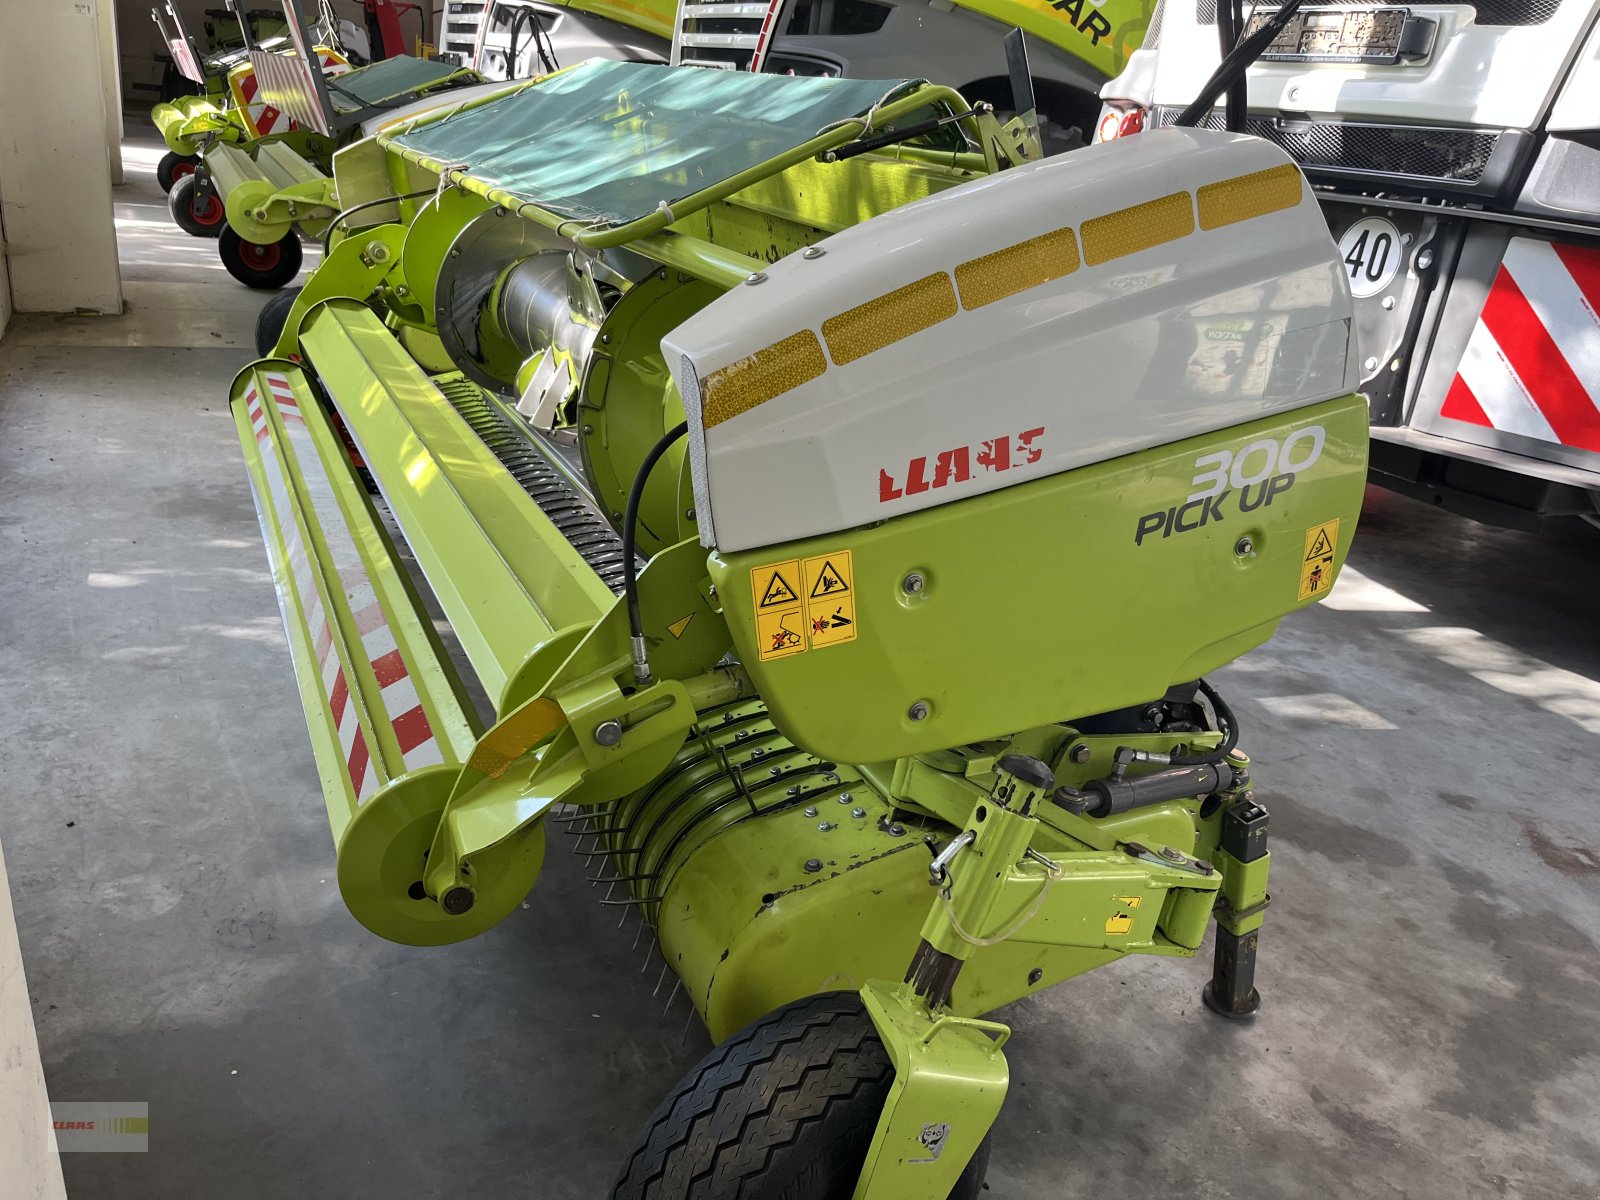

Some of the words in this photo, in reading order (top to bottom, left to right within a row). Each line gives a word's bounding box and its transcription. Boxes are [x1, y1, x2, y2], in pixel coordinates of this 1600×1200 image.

[1345, 229, 1392, 282] 40
[1187, 425, 1326, 503] 300
[1135, 490, 1231, 546] PICK
[1239, 472, 1296, 512] UP
